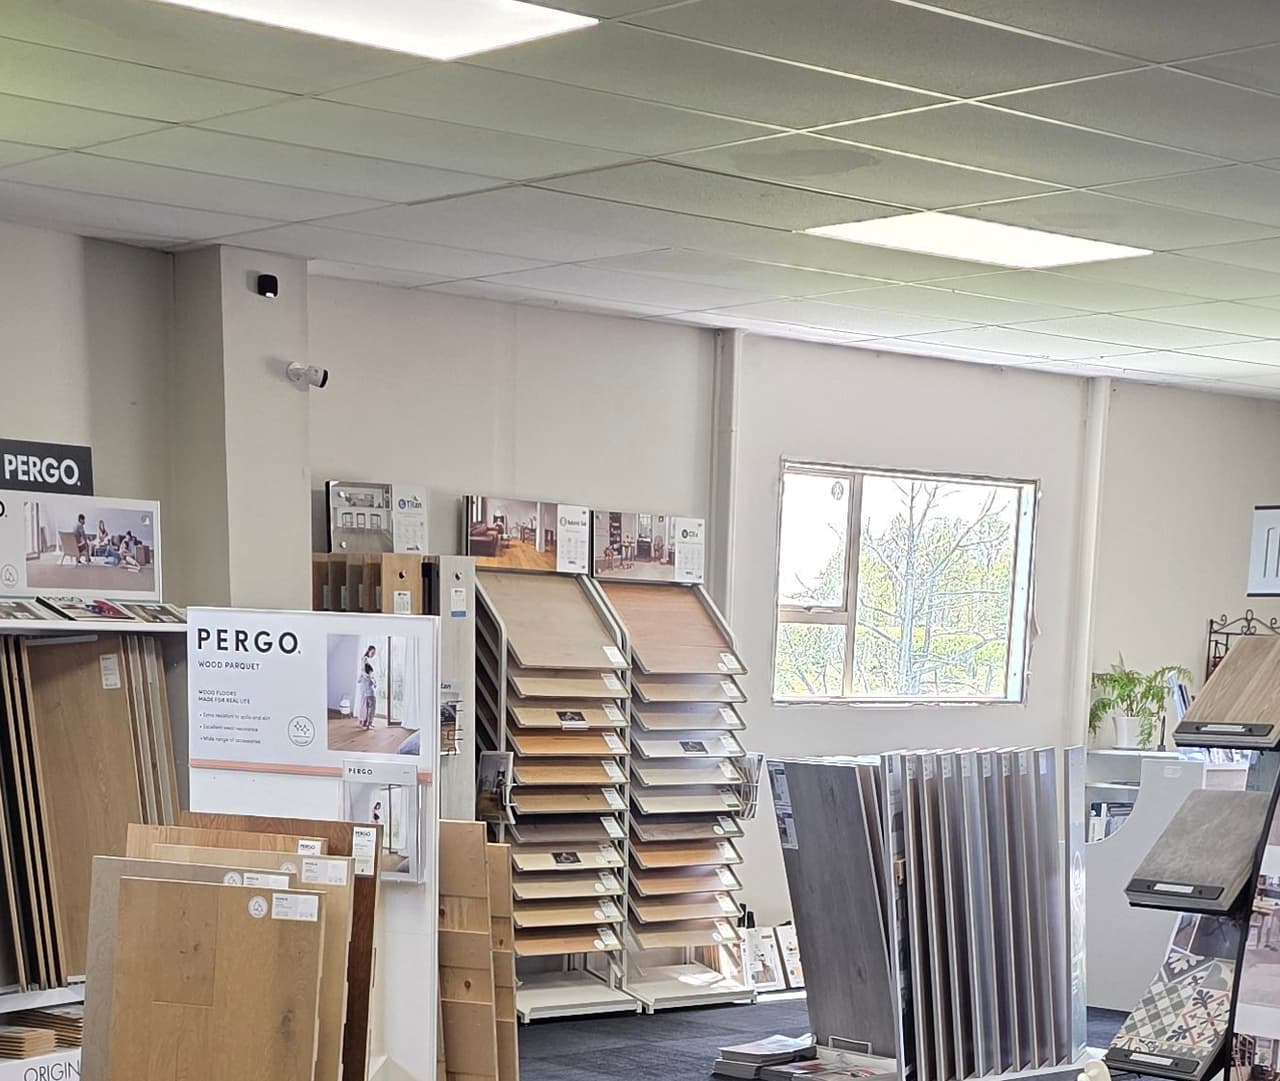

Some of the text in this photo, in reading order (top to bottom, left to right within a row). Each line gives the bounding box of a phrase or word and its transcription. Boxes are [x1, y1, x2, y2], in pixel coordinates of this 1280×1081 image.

[3, 453, 80, 486] PERGO
[197, 628, 299, 655] PERGO
[198, 660, 260, 671] WOOD PARQUET
[348, 767, 373, 775] PERGO
